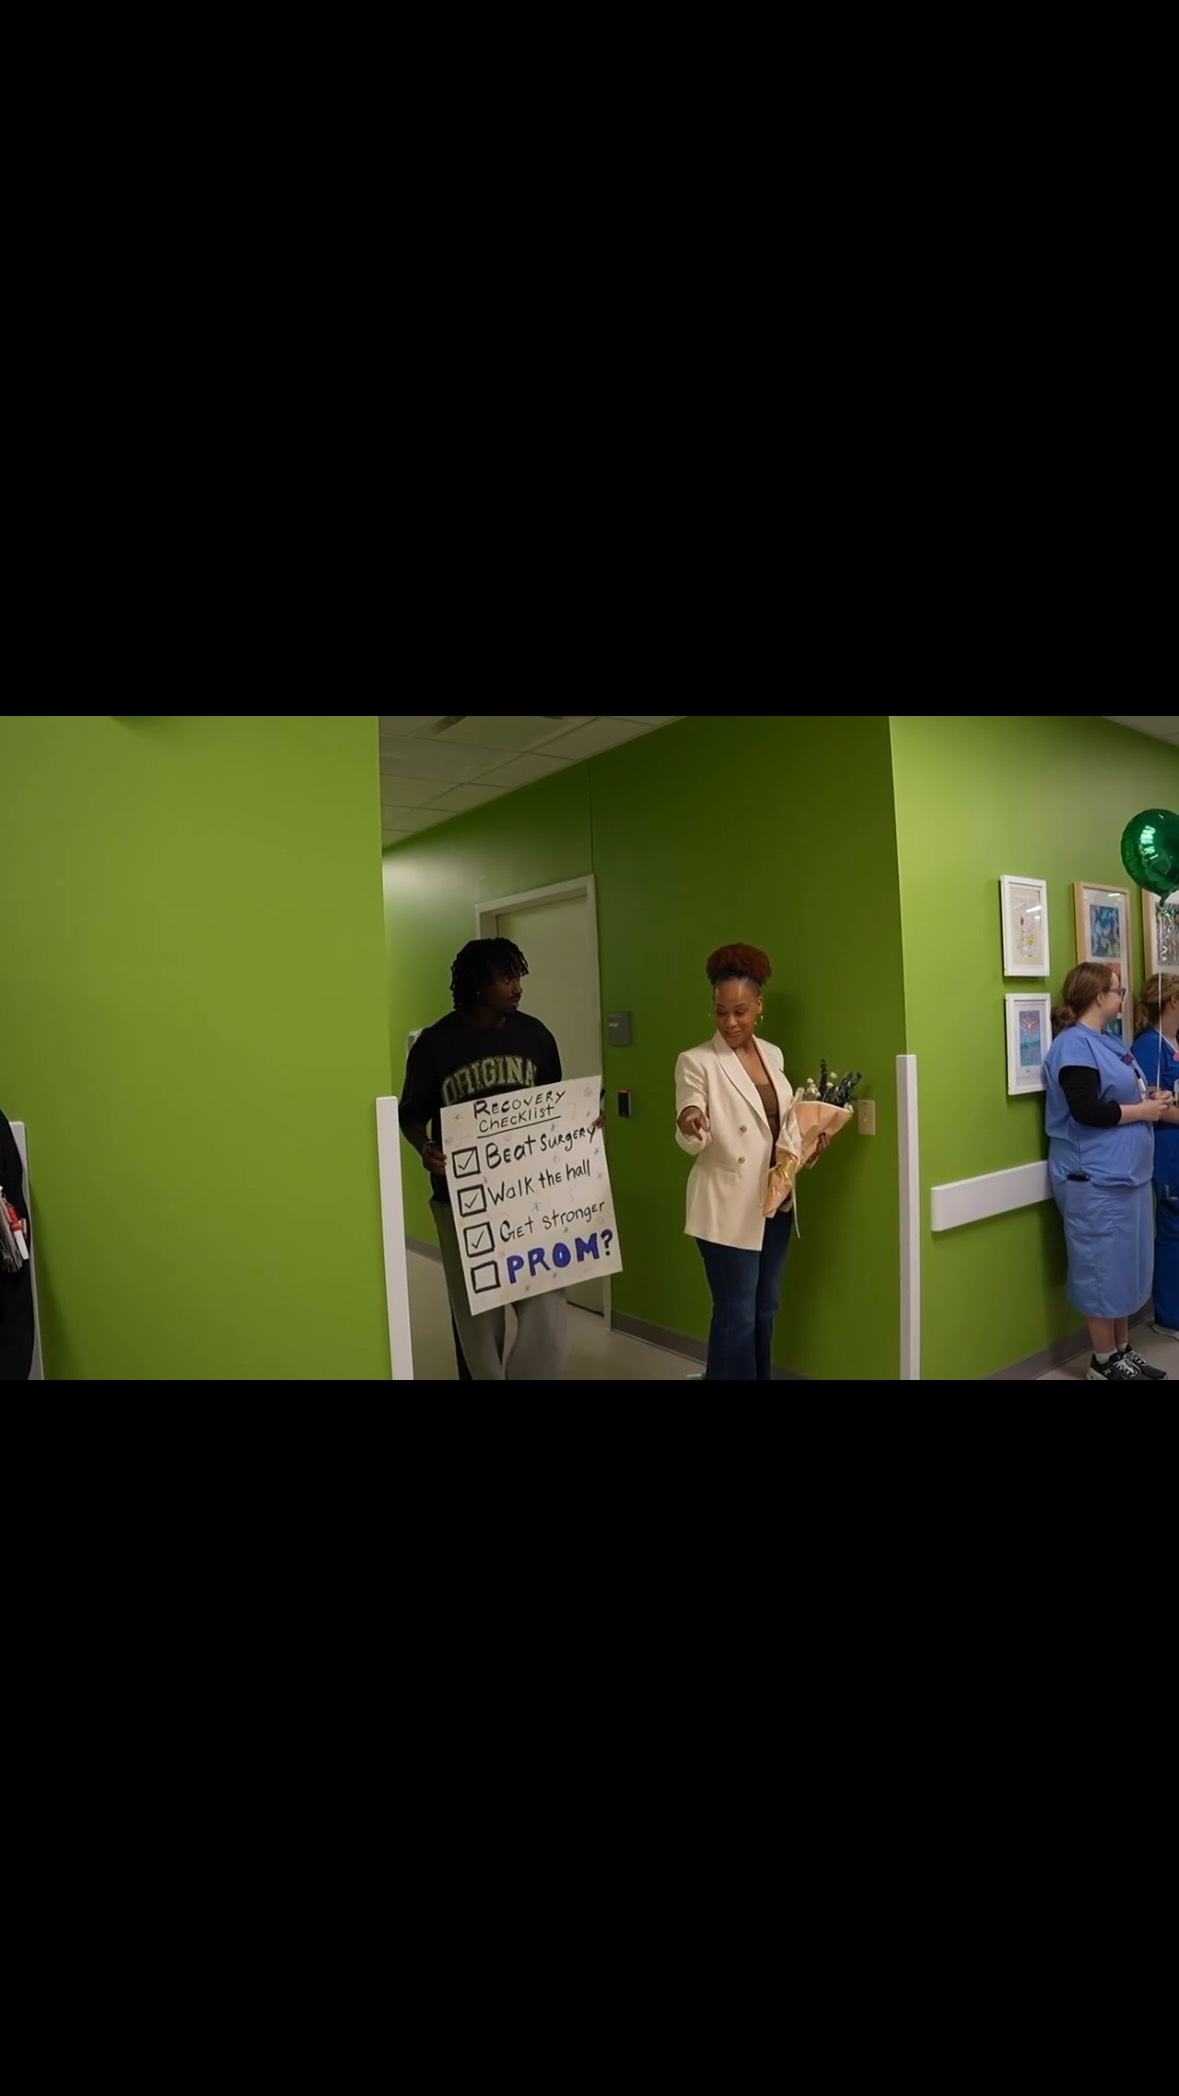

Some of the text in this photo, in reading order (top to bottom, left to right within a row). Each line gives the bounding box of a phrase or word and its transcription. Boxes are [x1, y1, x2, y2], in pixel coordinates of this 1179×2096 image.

[442, 1055, 537, 1106] ORIGINA
[473, 1090, 566, 1119] RECOVERY
[566, 1158, 591, 1181] hall
[506, 1229, 613, 1284] PROM?
